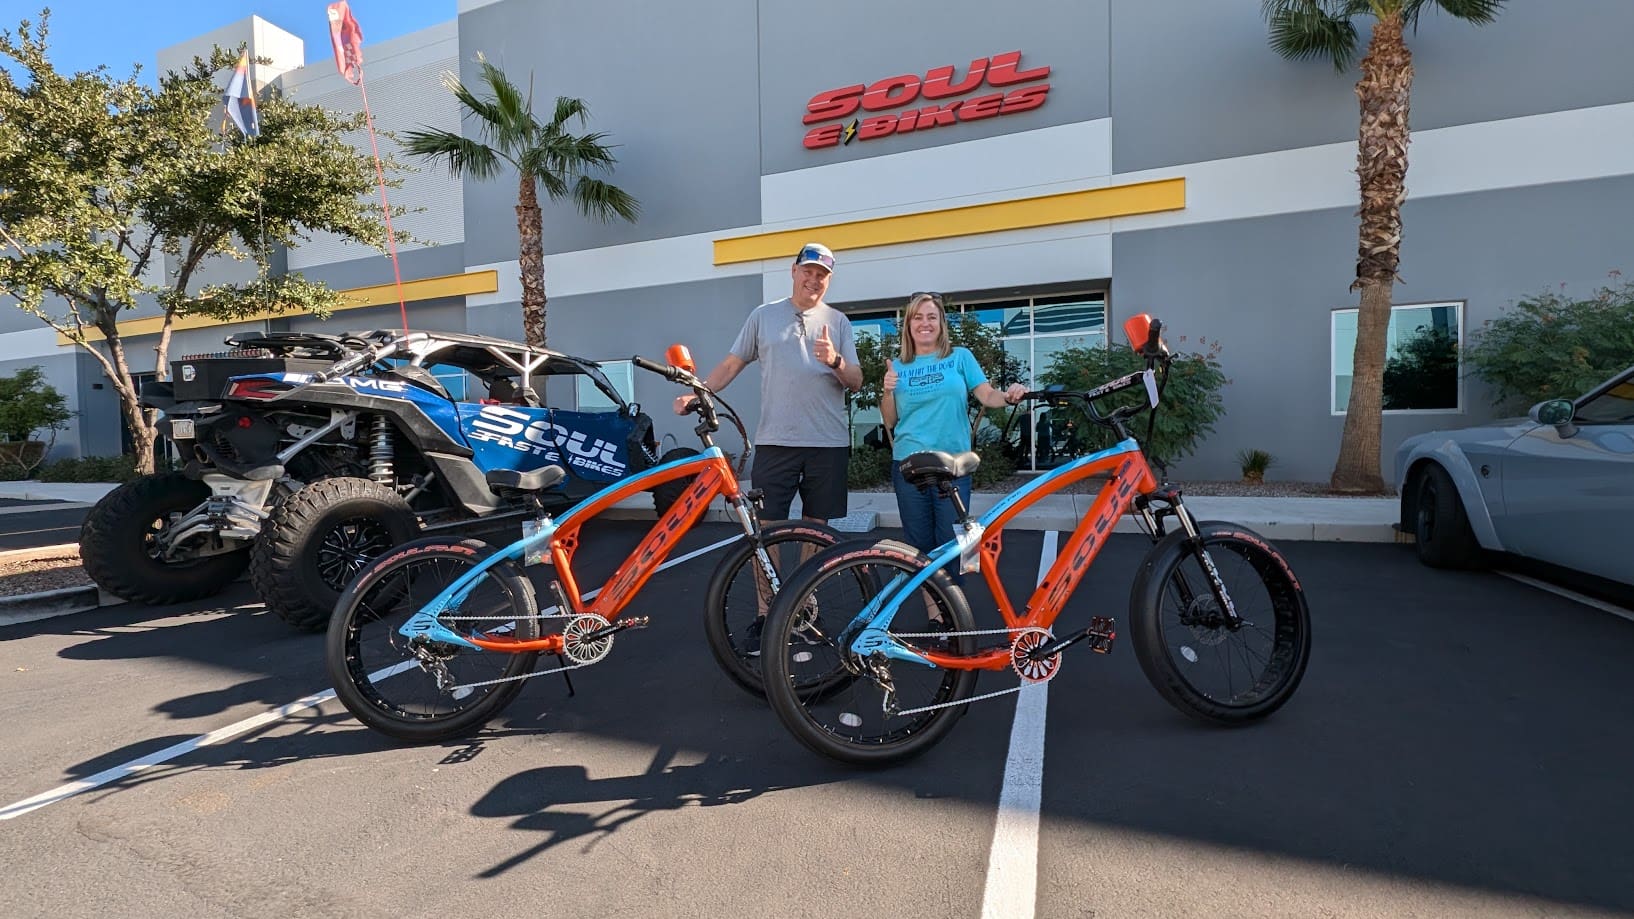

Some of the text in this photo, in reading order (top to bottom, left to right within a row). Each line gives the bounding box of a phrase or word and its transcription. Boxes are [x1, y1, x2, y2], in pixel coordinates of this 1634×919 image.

[802, 84, 1050, 149] E BIKES
[803, 50, 1050, 125] SOUL
[472, 406, 625, 469] SOUL
[478, 429, 546, 455] FAST
[572, 457, 624, 477] BIKES
[610, 472, 721, 600] SOUL
[1048, 469, 1144, 612] SOUL
